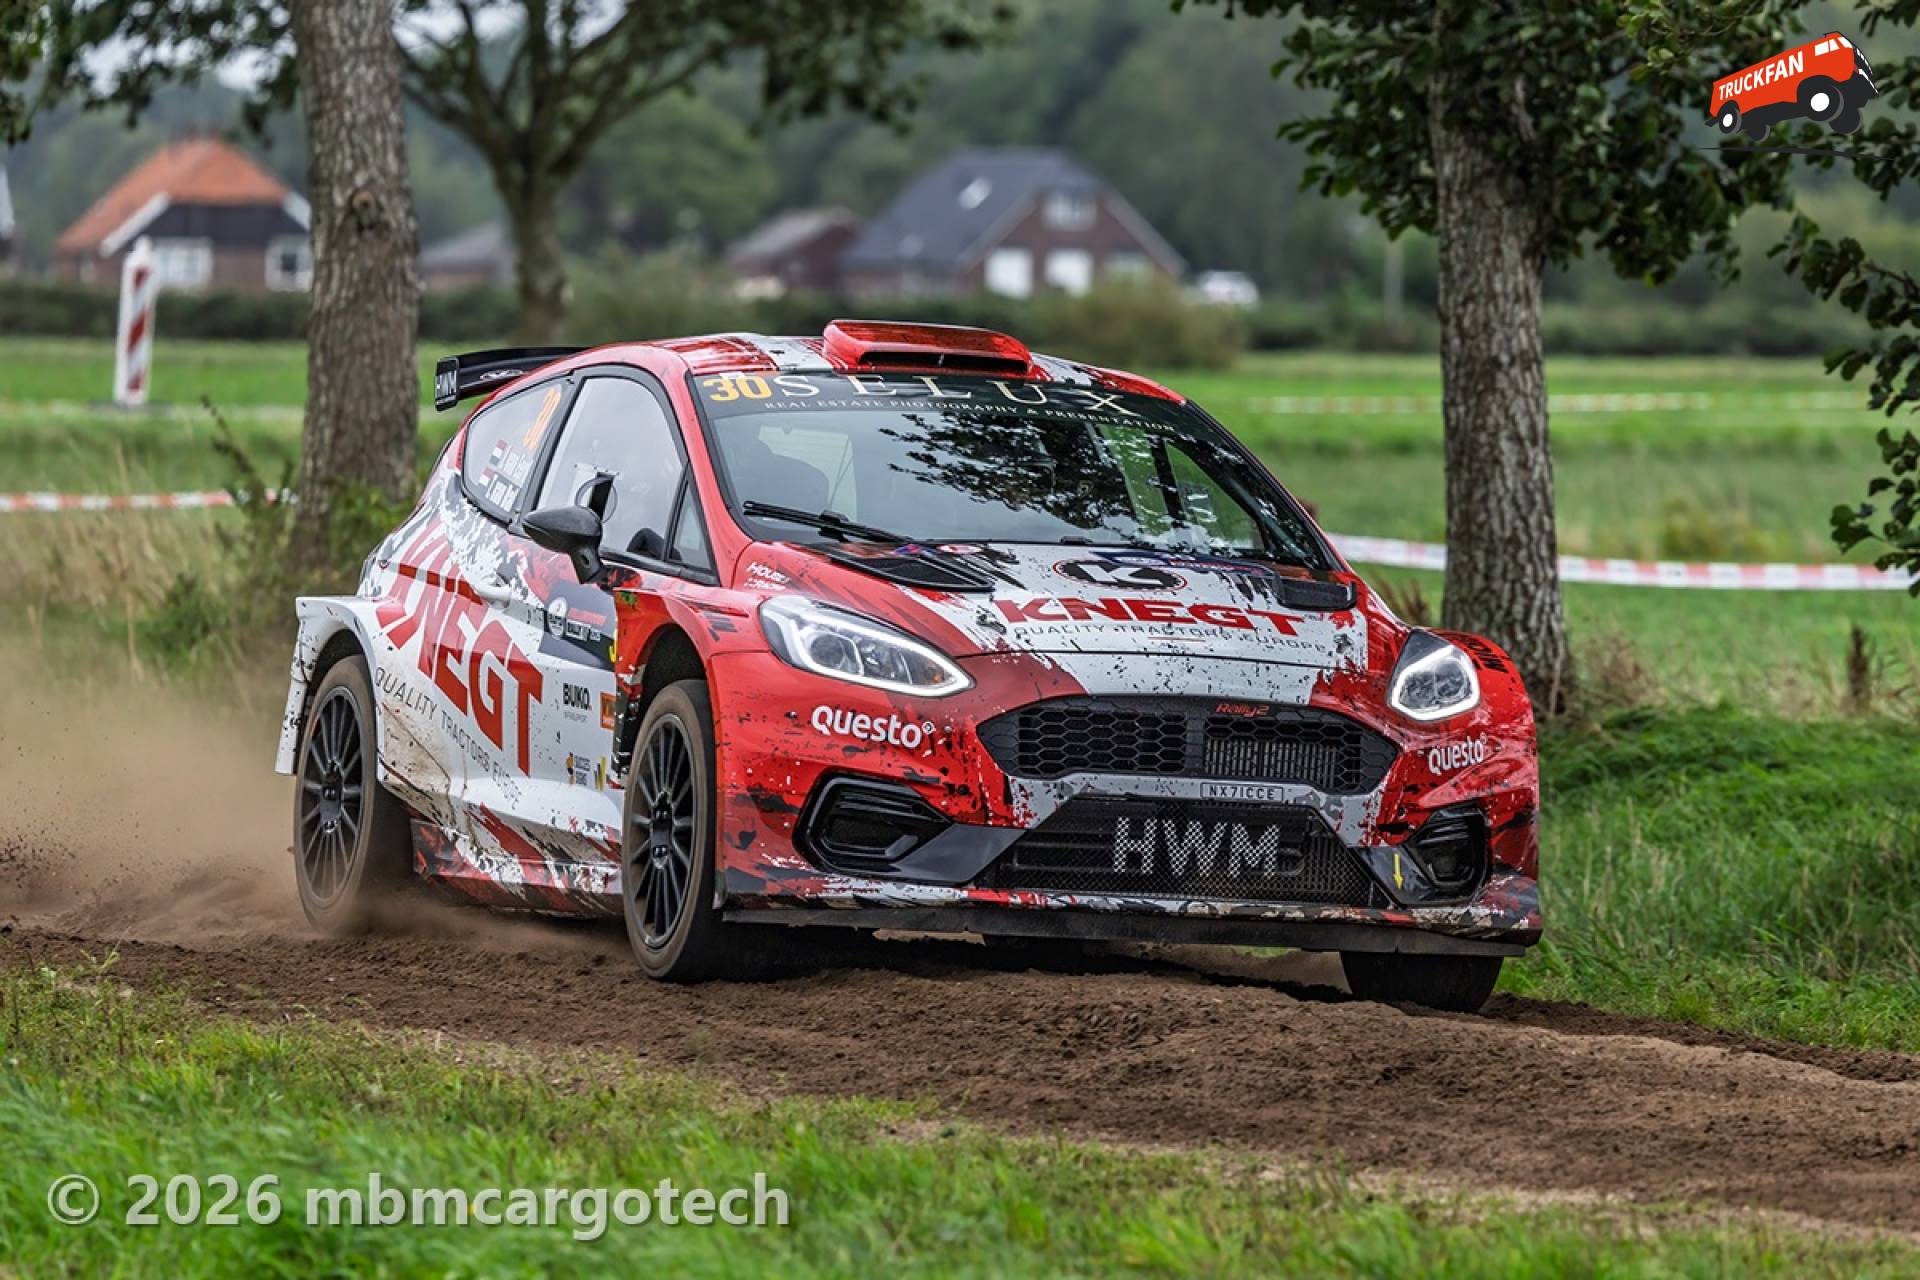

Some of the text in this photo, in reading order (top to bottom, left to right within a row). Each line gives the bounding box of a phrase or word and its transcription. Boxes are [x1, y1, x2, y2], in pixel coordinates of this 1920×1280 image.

[703, 376, 773, 401] 30
[773, 375, 1141, 417] SELUX
[764, 400, 811, 409] REAL
[818, 400, 884, 409] ESTATE
[891, 400, 1017, 414] PHOTOGRAPHY
[1045, 410, 1176, 433] PRESENTATION
[993, 597, 1305, 637] KNEGT
[1014, 624, 1105, 636] QUALITY
[1117, 624, 1232, 641] TRACTORS
[375, 667, 438, 721] QUALITY
[441, 710, 491, 773] TRACTORS
[1215, 703, 1270, 718] Rally2
[1112, 816, 1281, 878] HWM
